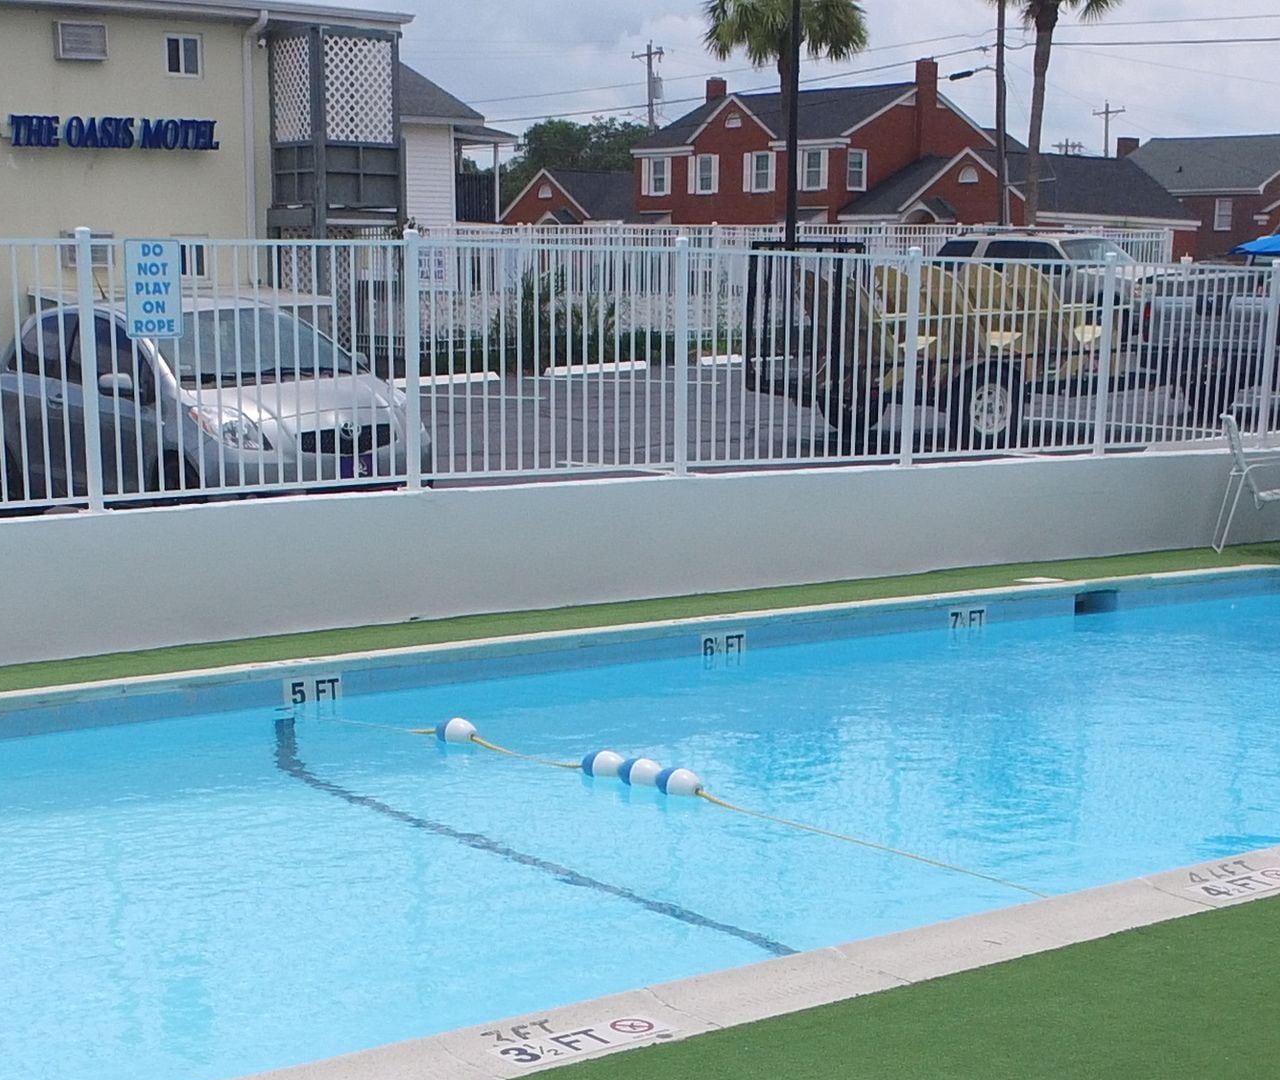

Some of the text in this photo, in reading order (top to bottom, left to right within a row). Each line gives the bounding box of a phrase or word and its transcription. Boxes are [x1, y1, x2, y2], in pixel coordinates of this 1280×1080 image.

[10, 115, 220, 151] THE OASIS MOTEL
[141, 243, 163, 257] DO
[137, 262, 168, 276] NOT
[135, 282, 171, 295] PLAY
[142, 301, 166, 314] ON
[134, 319, 175, 333] ROPE
[969, 609, 985, 628] FT
[725, 633, 744, 654] FT
[291, 678, 340, 704] 5 FT
[1225, 875, 1274, 891] FT
[549, 1028, 611, 1052] FT
